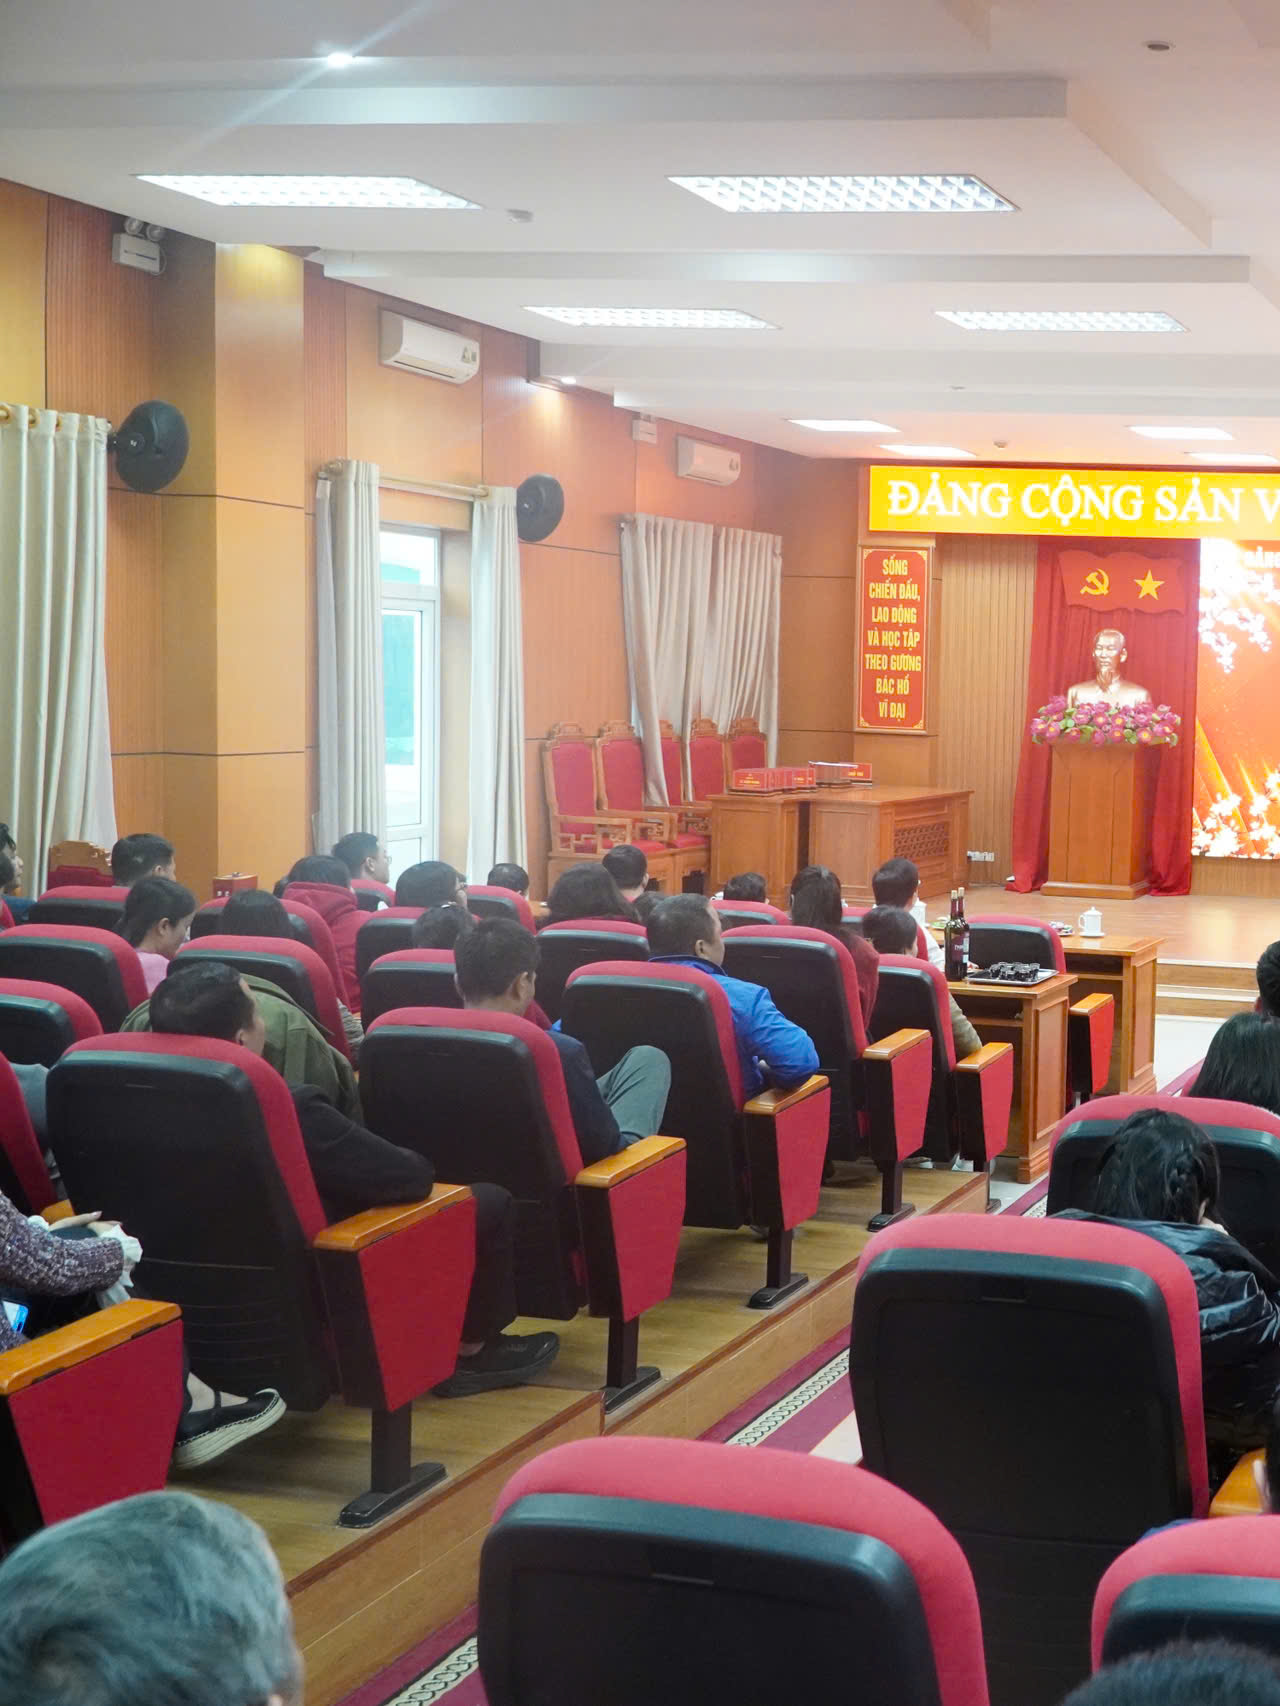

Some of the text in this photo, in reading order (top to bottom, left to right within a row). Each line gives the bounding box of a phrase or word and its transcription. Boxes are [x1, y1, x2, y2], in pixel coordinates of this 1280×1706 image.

[888, 472, 1012, 516] ĐẢNG
[1021, 474, 1144, 527] CỘNG
[1155, 477, 1244, 523] SẢN
[882, 554, 908, 576] SỐNG
[869, 577, 920, 602] CHIẾN ĐẤU,
[872, 604, 917, 626] LAO ĐỘNG
[867, 627, 920, 651] VÀ HỌC TẬP
[865, 653, 921, 671] THEO GƯƠNG
[876, 675, 894, 694] BÁC
[879, 698, 906, 722] VĨ ĐẠI
